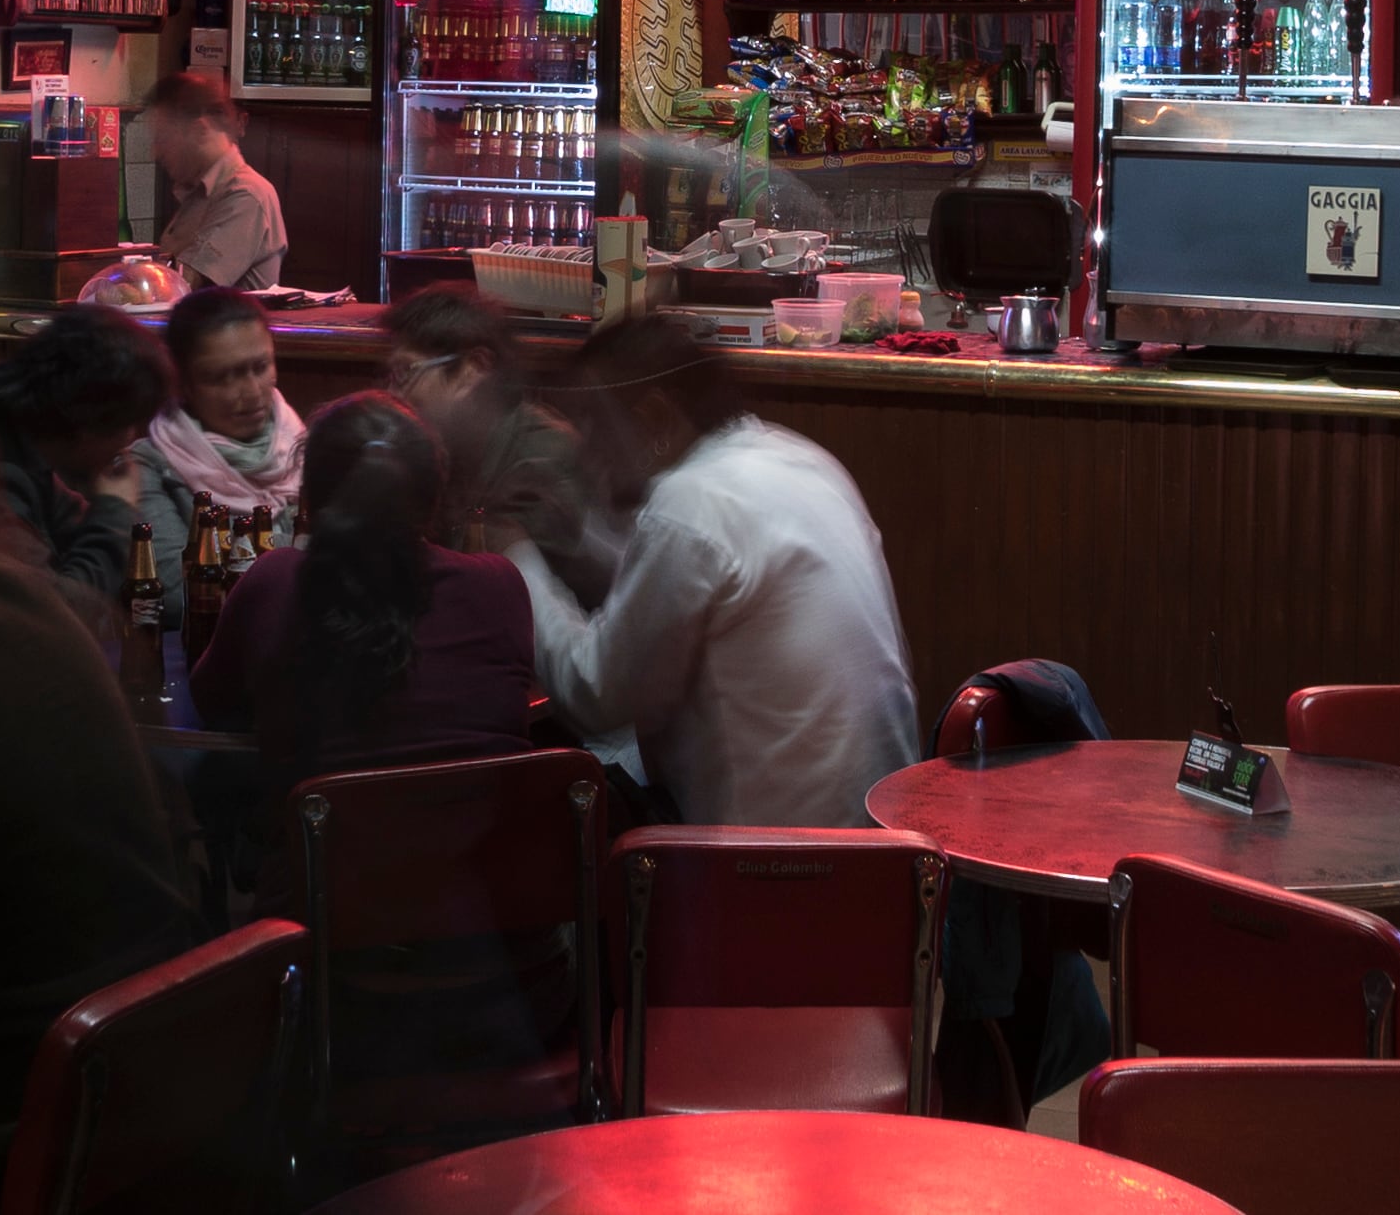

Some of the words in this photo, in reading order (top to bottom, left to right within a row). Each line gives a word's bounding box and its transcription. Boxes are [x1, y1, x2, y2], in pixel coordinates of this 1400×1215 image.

[851, 152, 888, 163] PRUEBA
[889, 152, 902, 162] LO
[1310, 190, 1378, 212] GAGGIA
